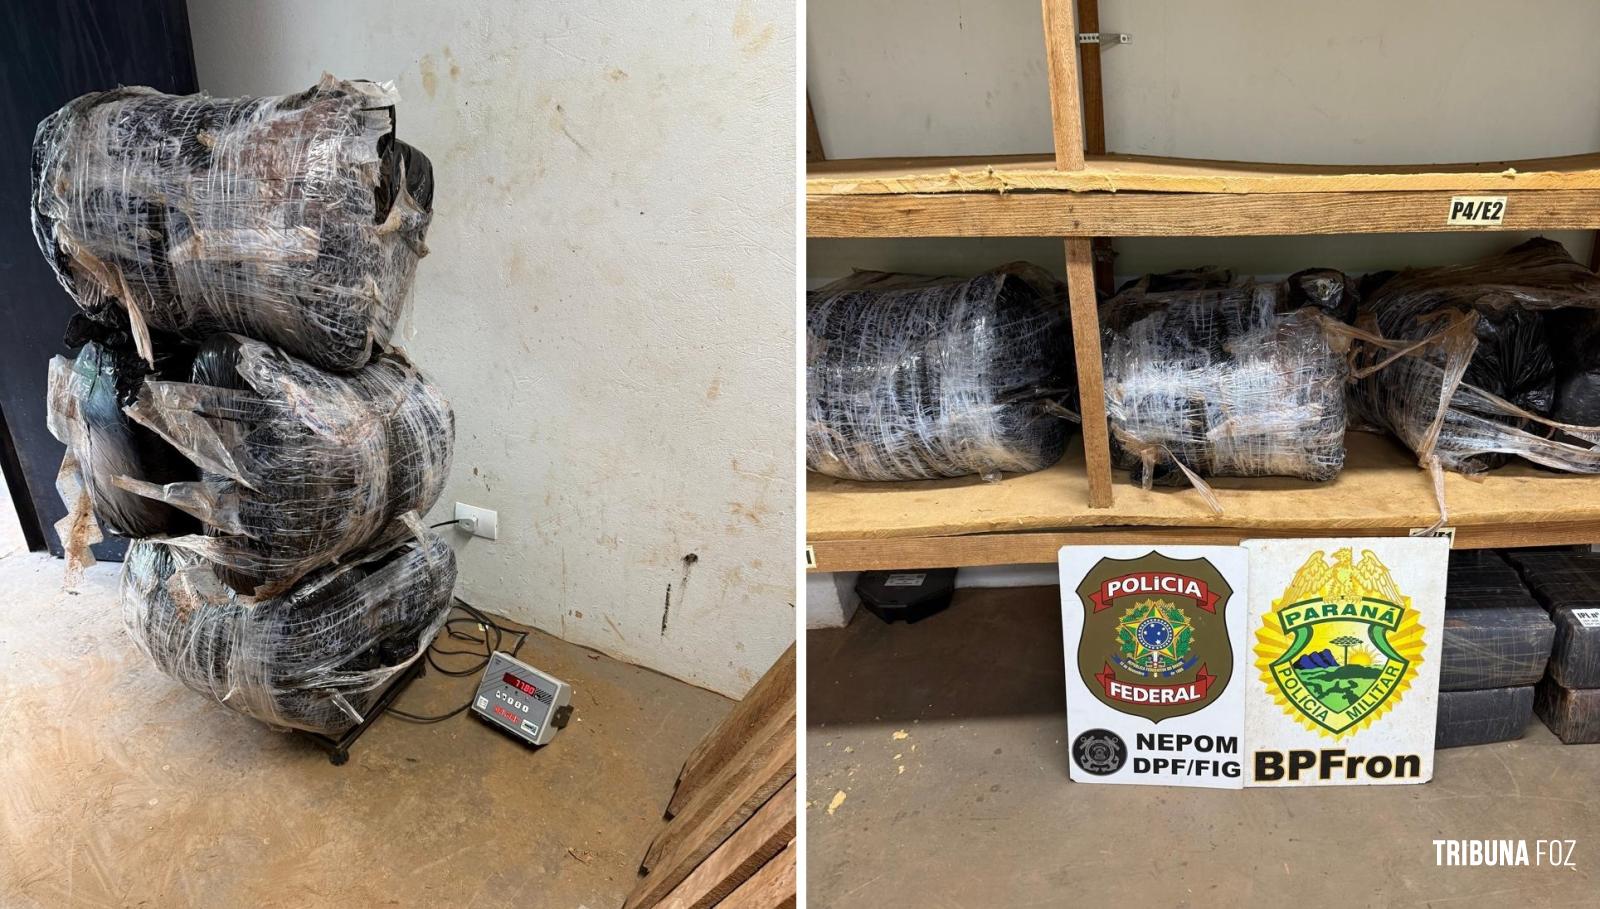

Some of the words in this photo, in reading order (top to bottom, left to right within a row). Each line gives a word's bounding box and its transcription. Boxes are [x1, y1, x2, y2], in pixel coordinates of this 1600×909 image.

[1451, 201, 1504, 220] P4/E2
[1285, 603, 1395, 626] PARANÁ
[1110, 682, 1200, 703] FEDERAL
[1278, 666, 1329, 722] POLÍCIA
[1345, 665, 1400, 721] MILITAR
[1136, 733, 1238, 754] NEPOM
[1133, 757, 1241, 778] DPF/FIG
[1254, 749, 1421, 782] BPFron
